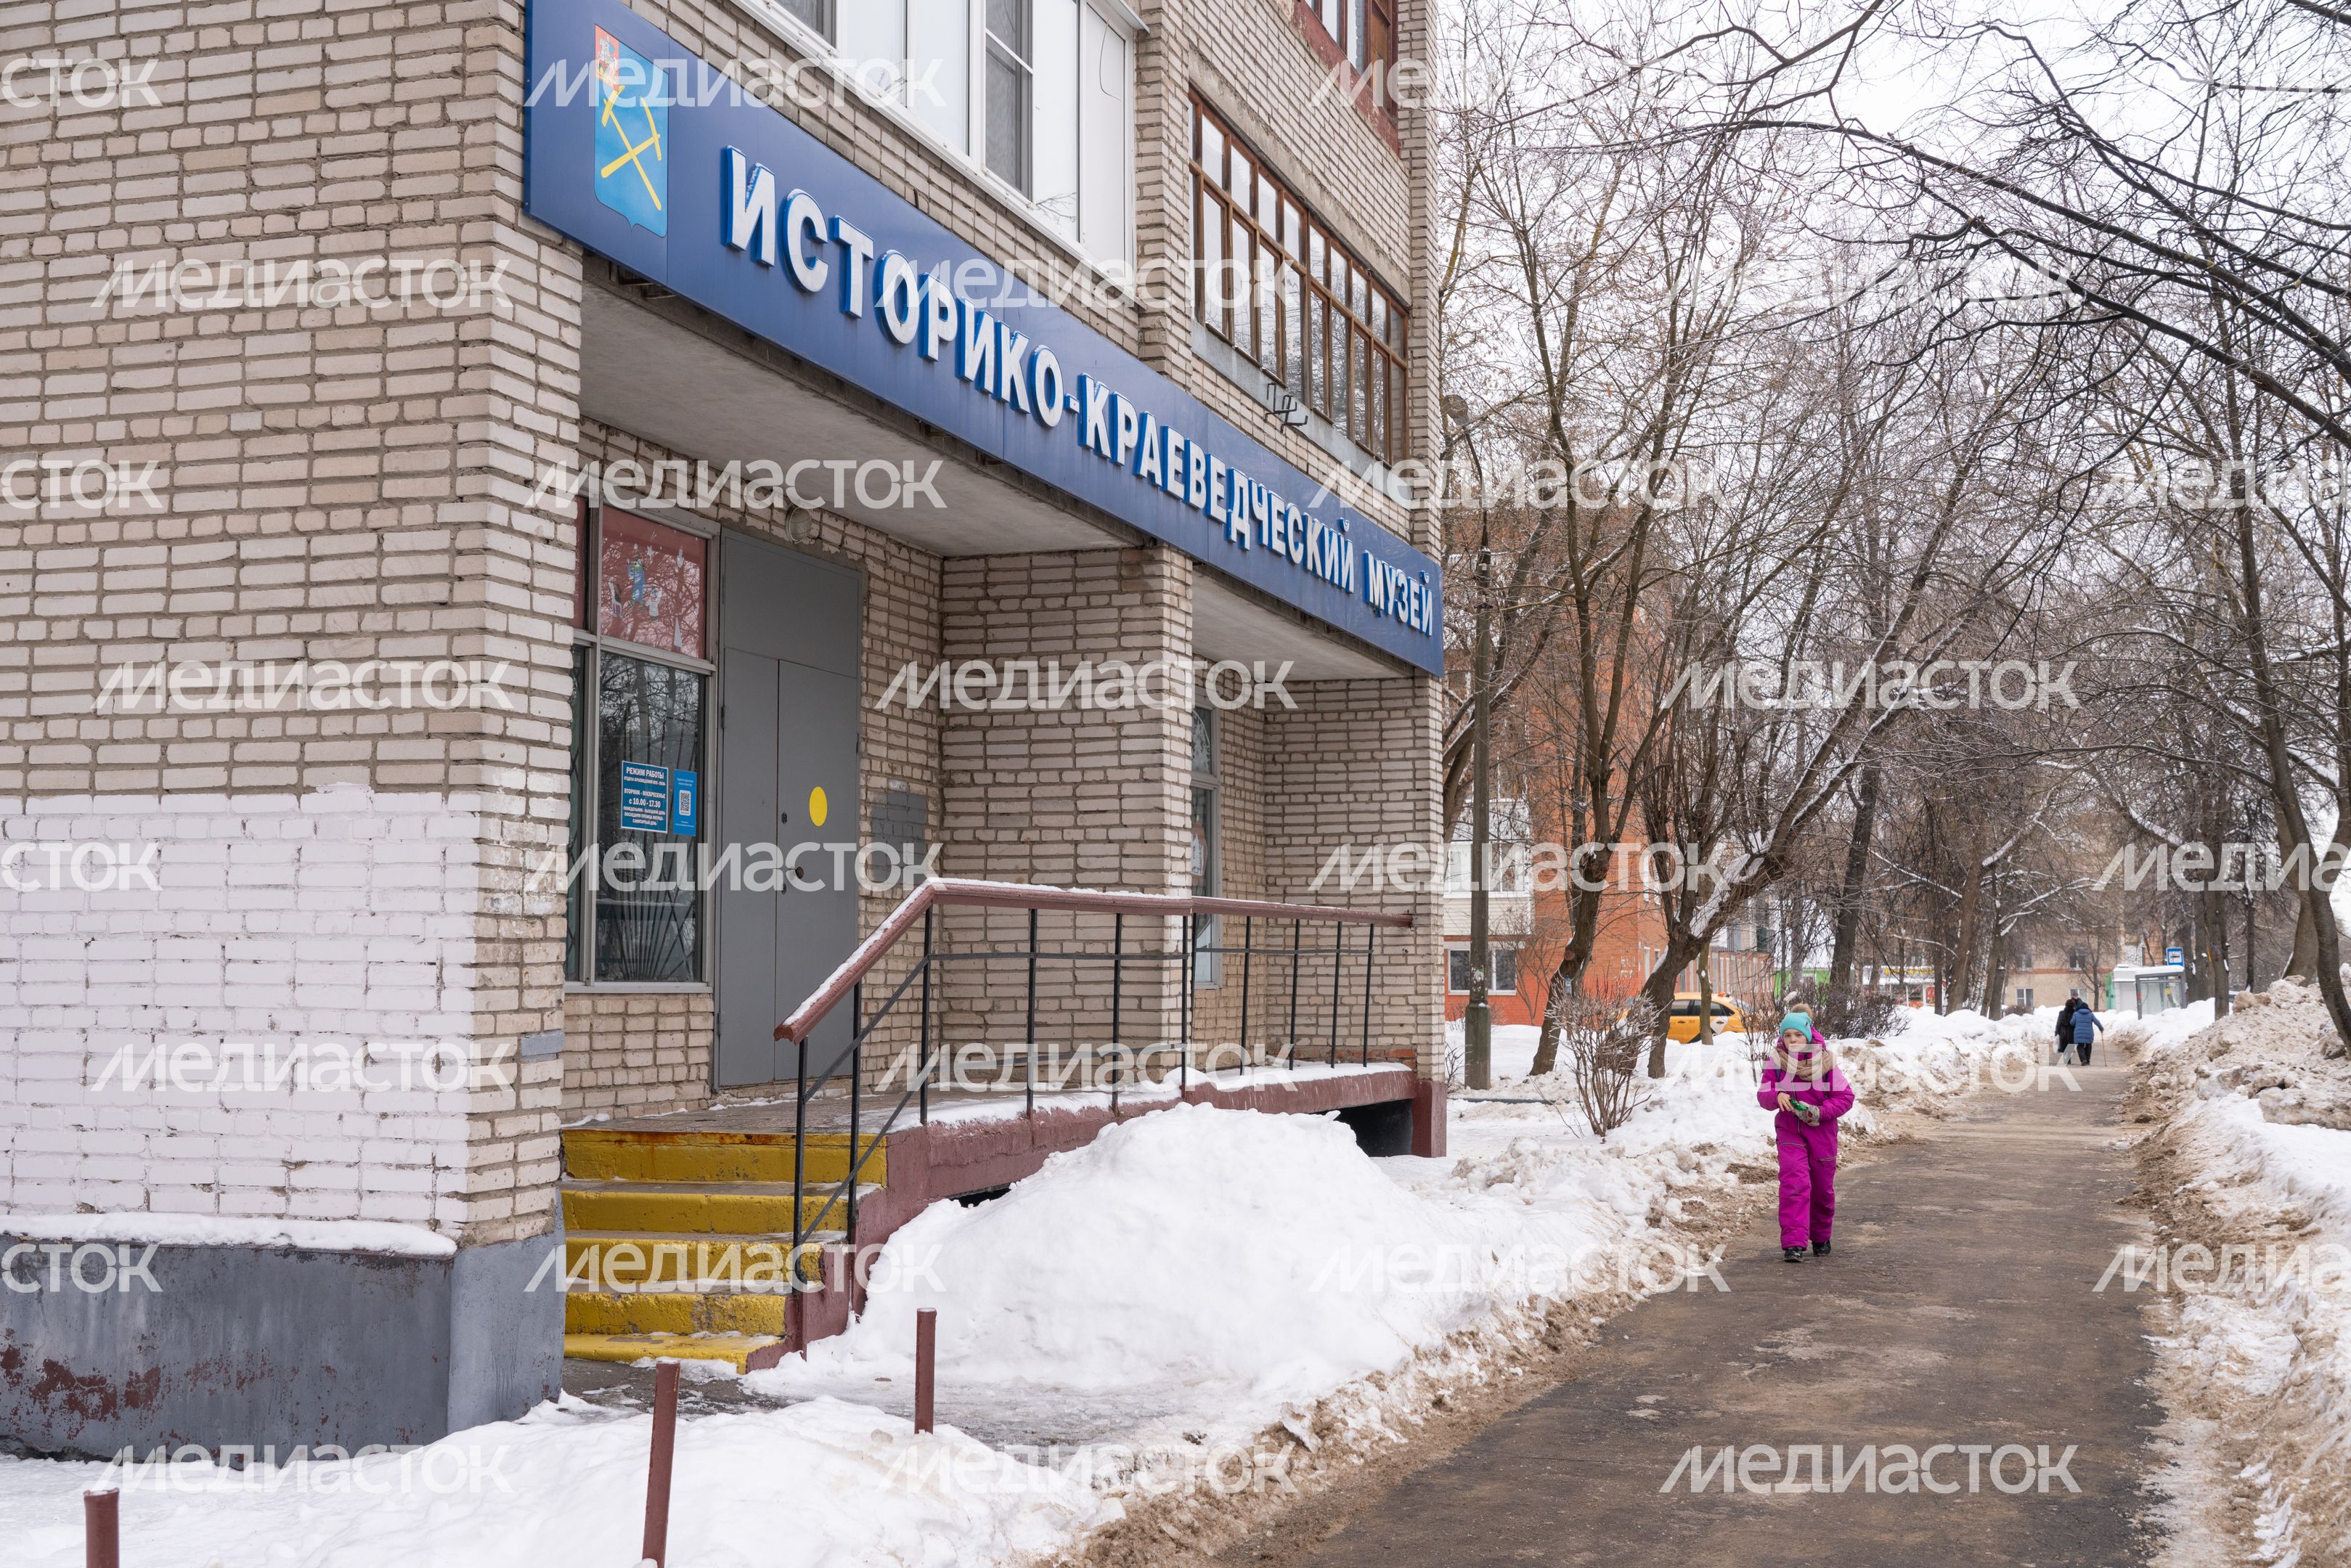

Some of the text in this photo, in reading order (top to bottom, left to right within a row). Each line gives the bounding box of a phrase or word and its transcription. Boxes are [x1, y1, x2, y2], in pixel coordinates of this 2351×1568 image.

[720, 145, 1433, 637] ИСТОРИКО-КРАЕВЕДЧЕСКИЙ МУЗЕЙ
[627, 767, 664, 779] РЕЖИМ РАБОТЫ
